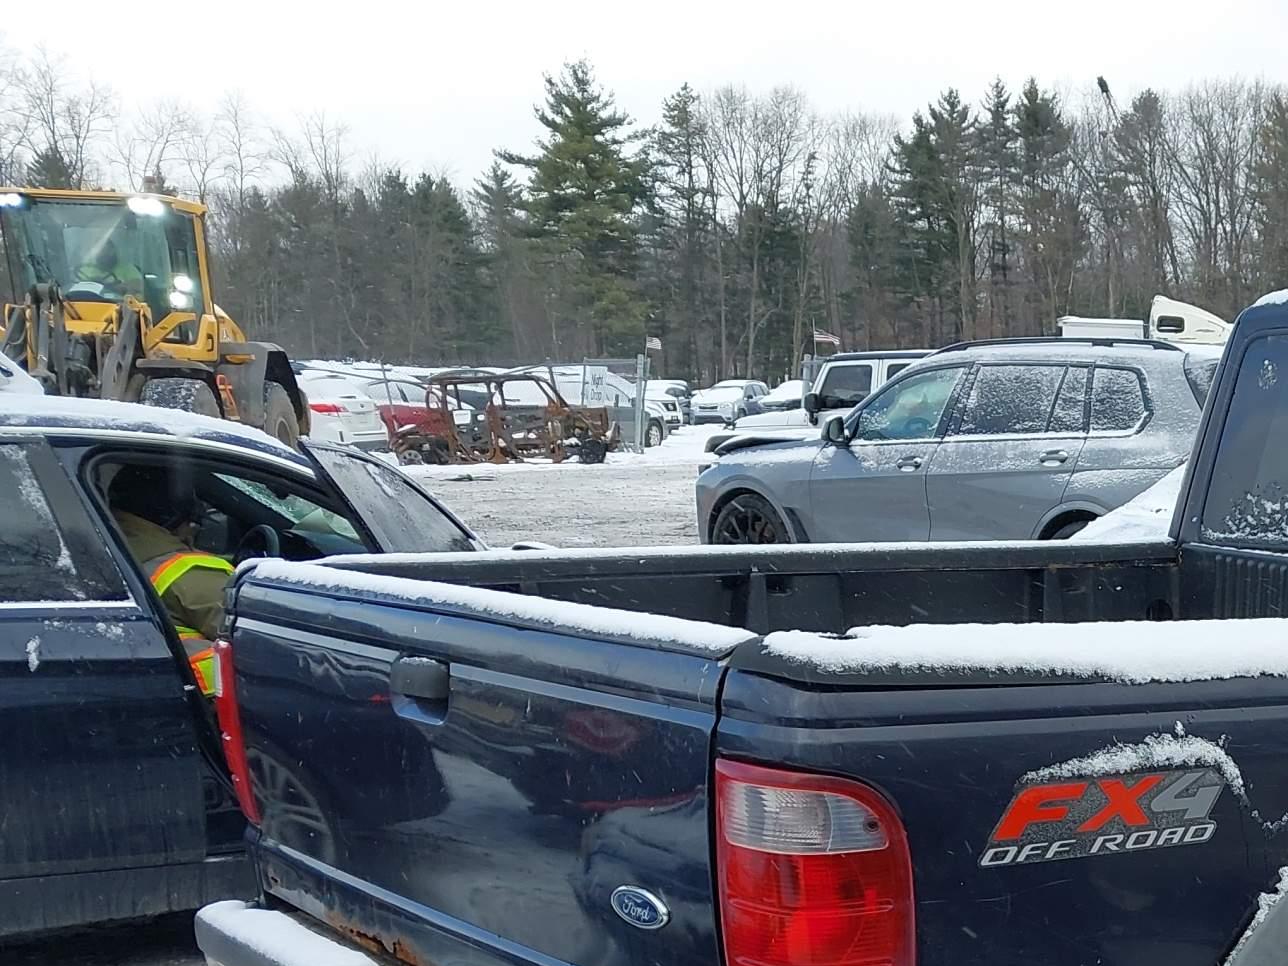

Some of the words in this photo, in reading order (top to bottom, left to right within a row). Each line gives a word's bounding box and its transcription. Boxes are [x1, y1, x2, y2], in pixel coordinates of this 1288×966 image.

[993, 772, 1220, 841] FX4
[979, 839, 1077, 867] OFF
[1090, 823, 1217, 853] ROAD
[622, 895, 651, 921] Ford
